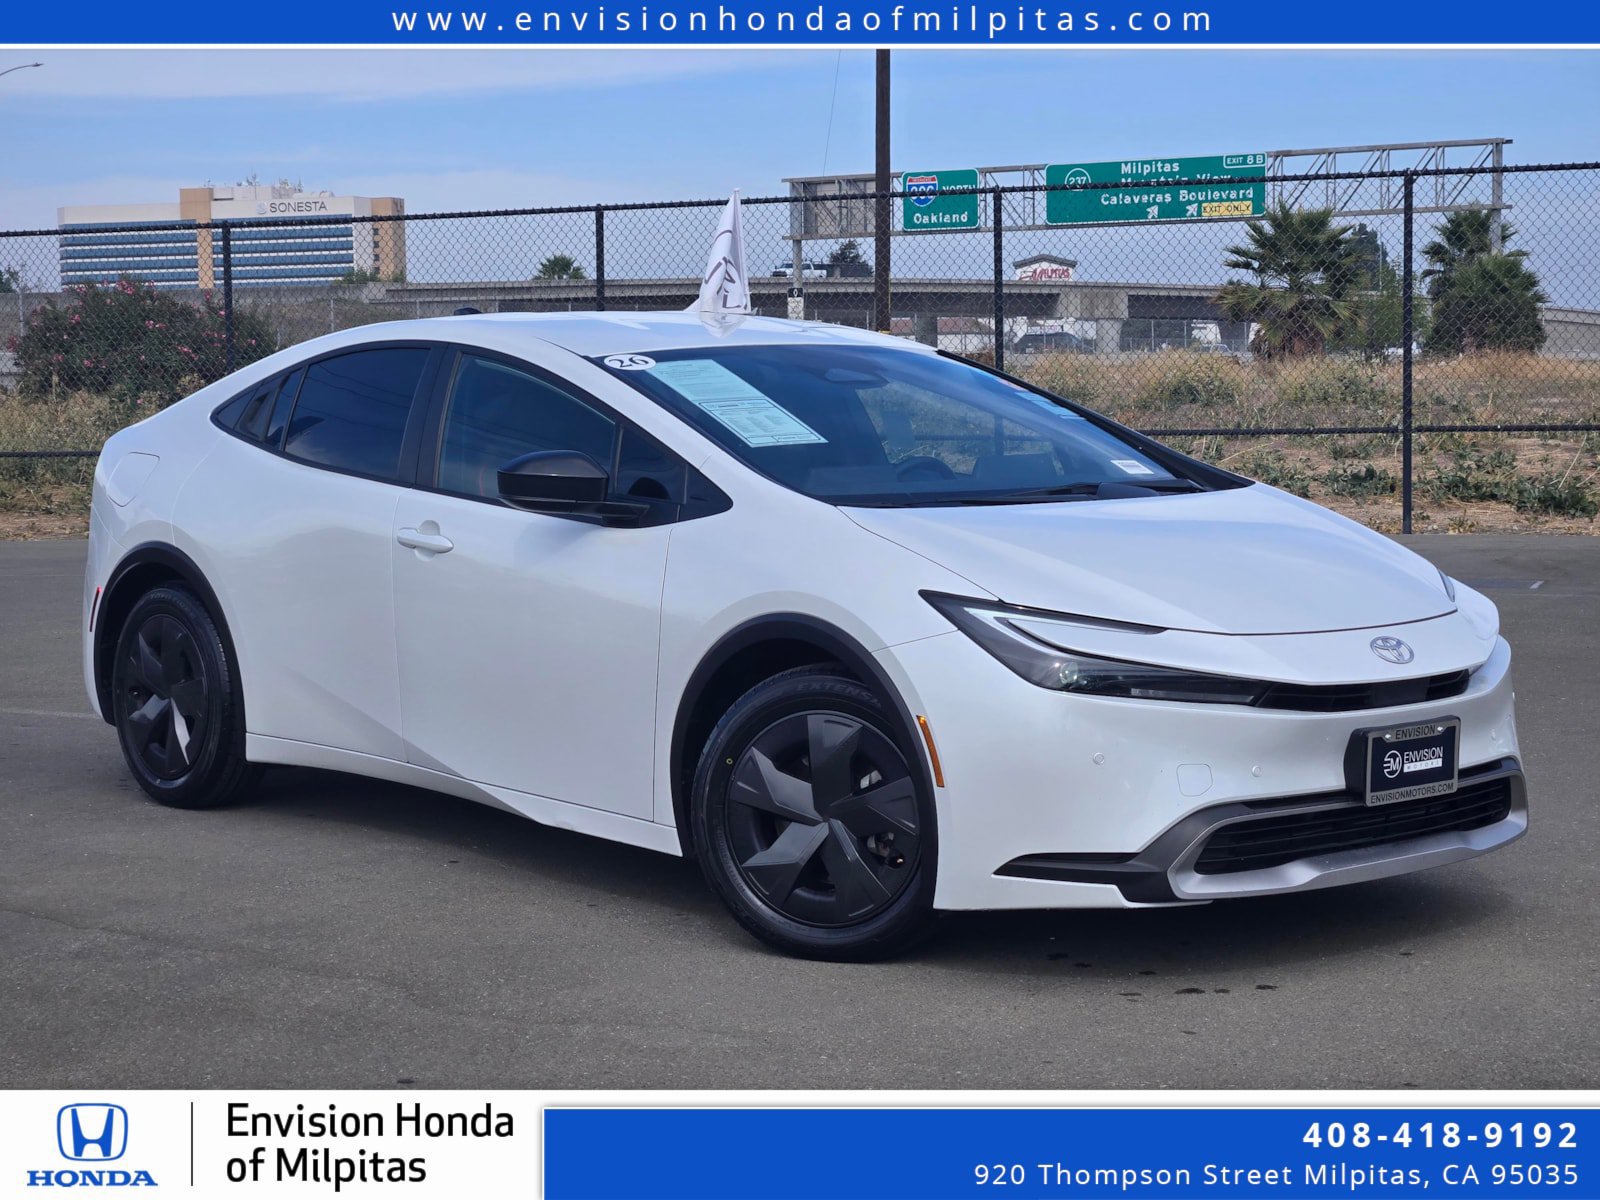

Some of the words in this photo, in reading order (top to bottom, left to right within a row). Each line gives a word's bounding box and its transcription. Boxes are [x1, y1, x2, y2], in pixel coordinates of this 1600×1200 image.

[1226, 157, 1243, 165] EXIT
[1121, 161, 1180, 176] Milpitas
[1101, 193, 1172, 205] Calaveras
[1179, 187, 1254, 202] Boulevard
[269, 201, 328, 213] SONESTA
[1203, 205, 1222, 213] EXIT
[1226, 204, 1250, 213] ONLY
[913, 211, 968, 224] Oakland
[609, 356, 650, 368] 26
[1395, 725, 1436, 740] ENVISION
[1403, 746, 1443, 764] ENVISION
[1370, 782, 1454, 804] ENVISIONMOTORS.COM
